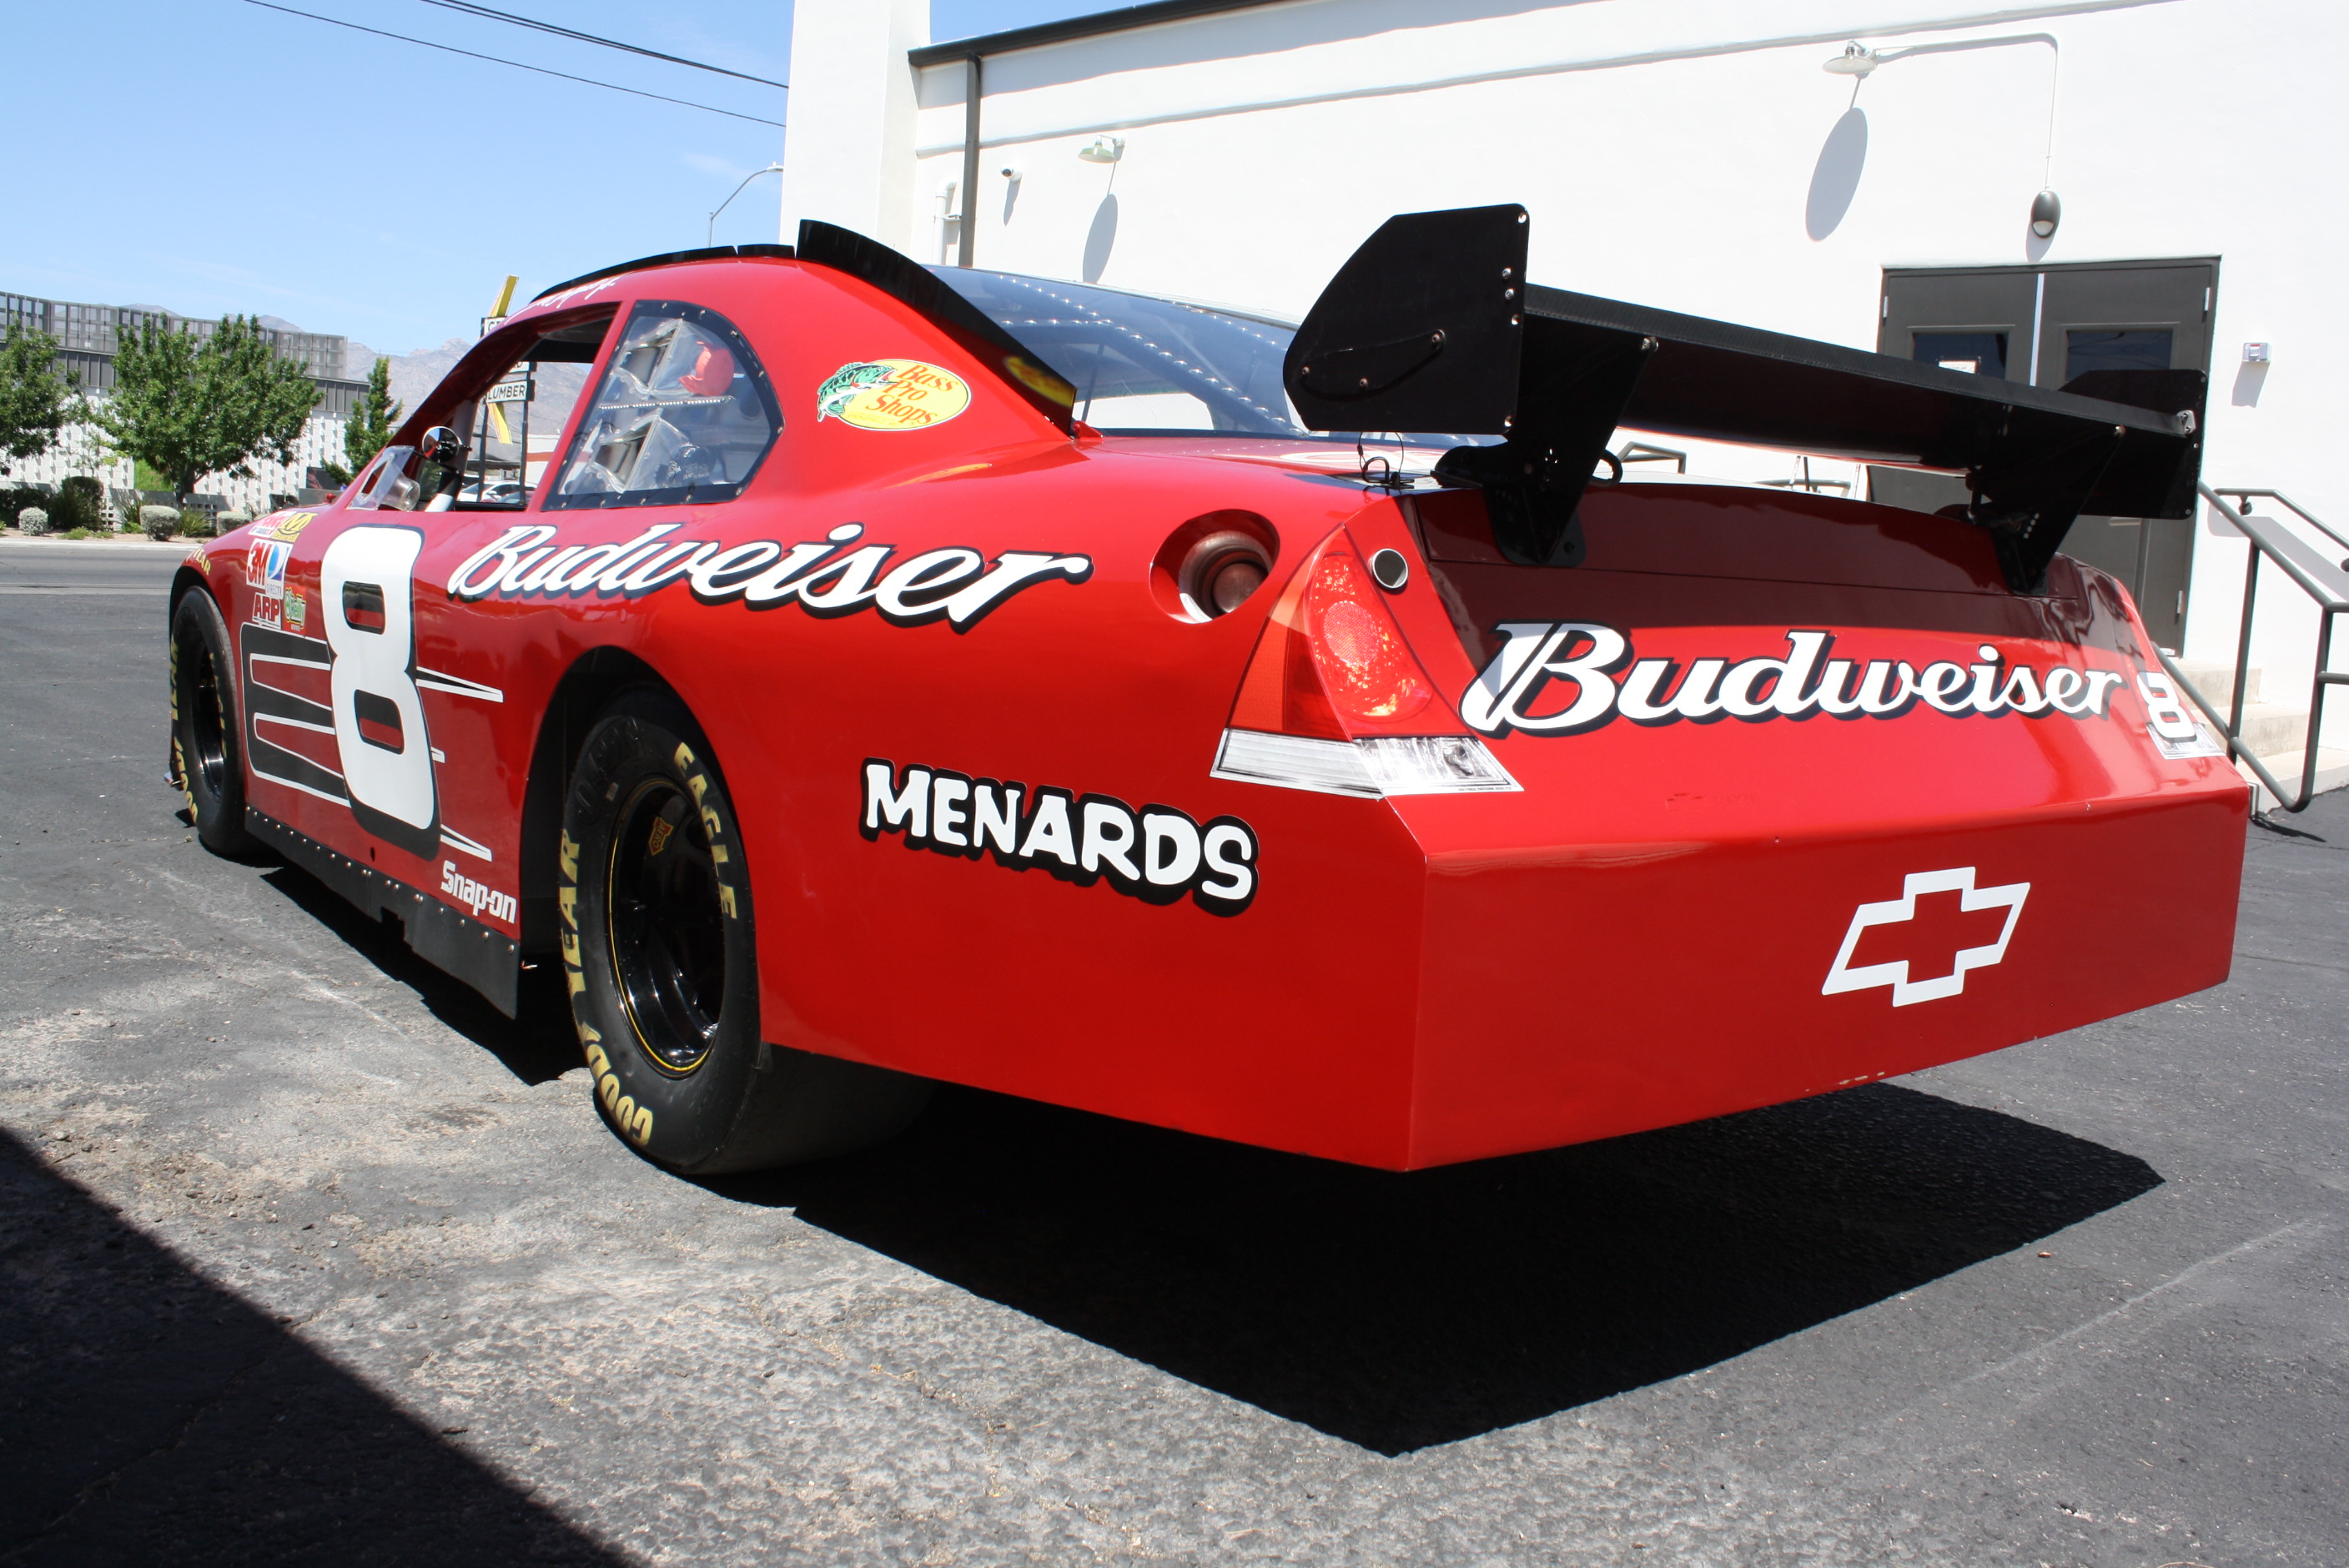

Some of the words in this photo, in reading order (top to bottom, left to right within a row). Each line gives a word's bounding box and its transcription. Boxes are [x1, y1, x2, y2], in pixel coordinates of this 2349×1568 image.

[487, 384, 526, 400] LUMBER
[866, 395, 938, 425] Shops
[883, 379, 928, 401] Pro
[897, 364, 959, 392] Bass
[247, 541, 273, 586] 3M
[447, 523, 1093, 630] Budweiser
[253, 595, 279, 622] ARP
[321, 525, 437, 834] 8
[1461, 623, 2125, 735] Budweiser
[2137, 671, 2196, 741] 8
[674, 742, 737, 919] EAGLE
[864, 762, 1254, 901] MENARDS
[440, 860, 517, 924] Snap-on
